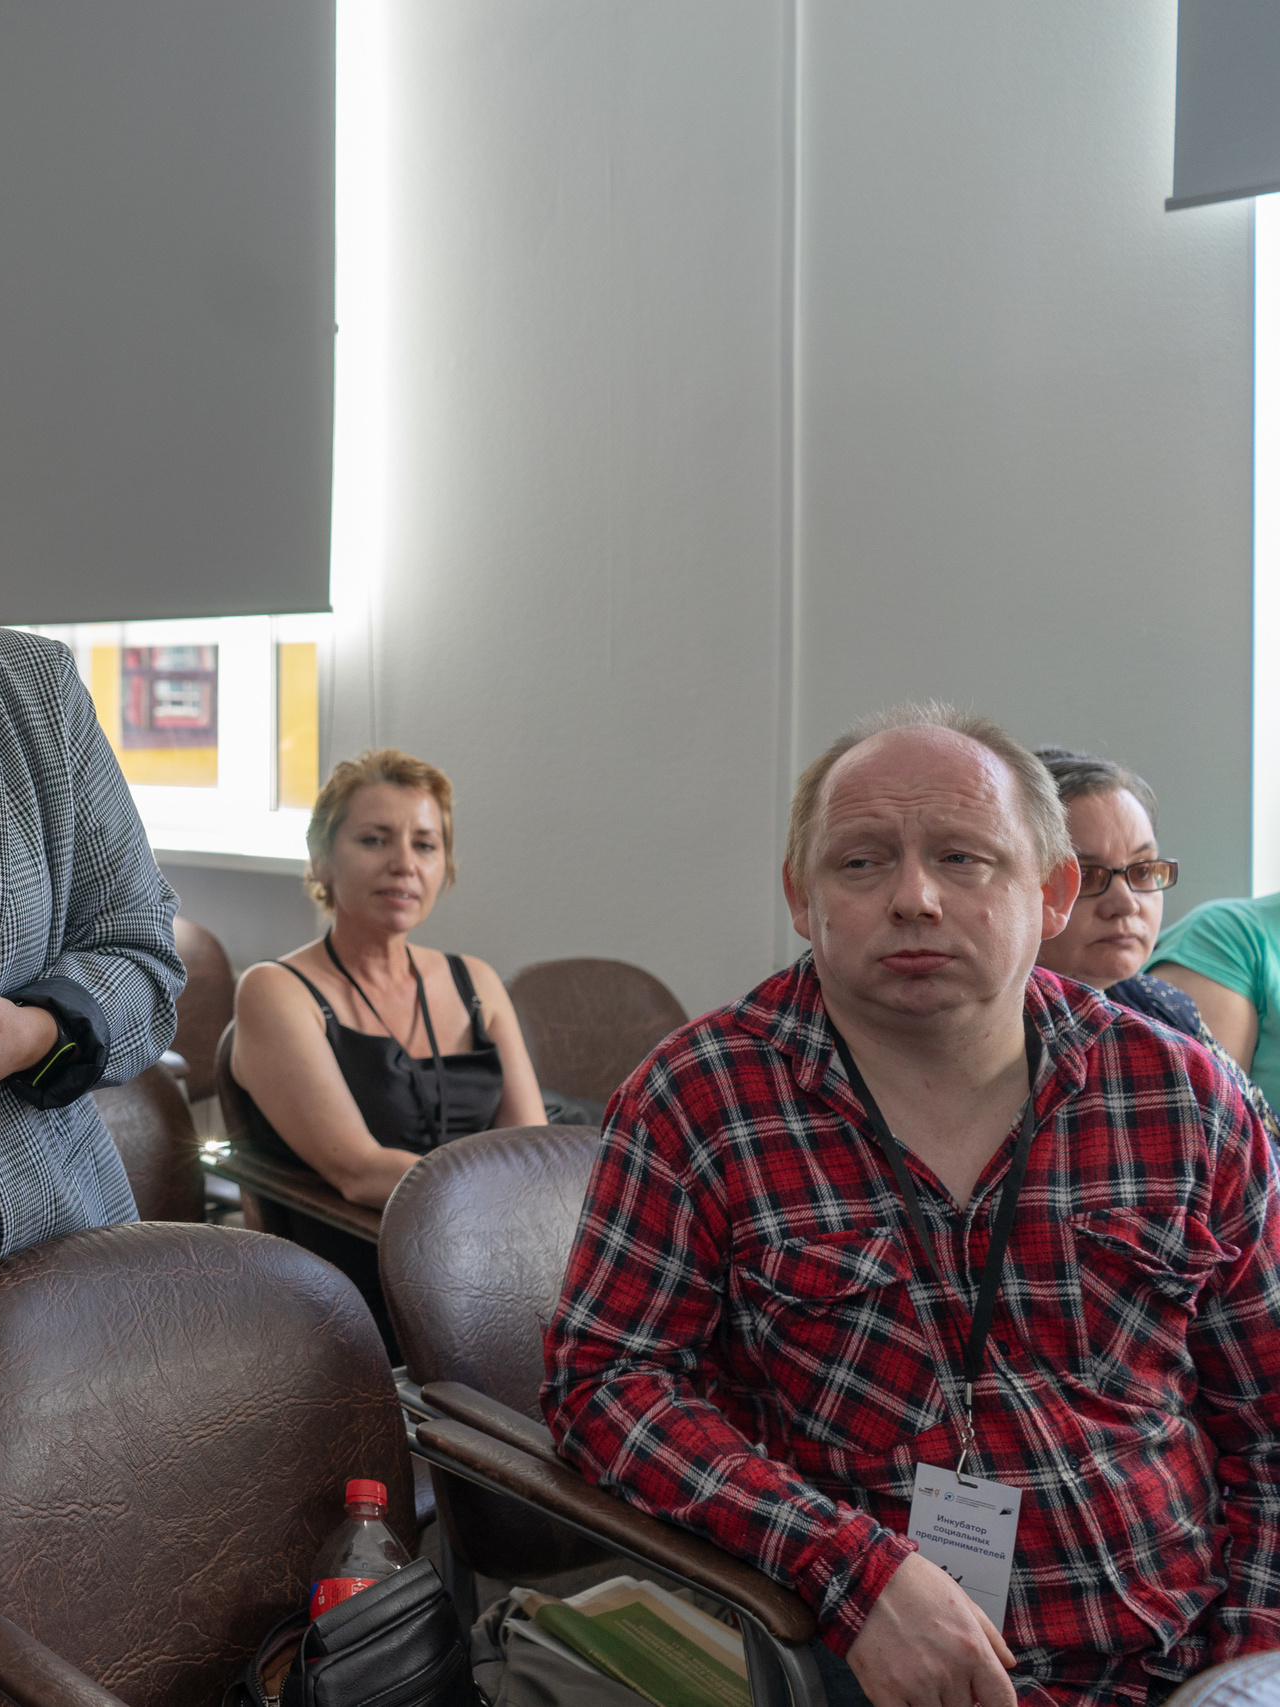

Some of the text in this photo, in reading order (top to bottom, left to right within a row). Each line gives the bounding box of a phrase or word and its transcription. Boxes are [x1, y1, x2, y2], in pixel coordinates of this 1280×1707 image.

[933, 1524, 990, 1546] социальных
[936, 1514, 987, 1536] Инкубатор
[915, 1530, 1006, 1560] предпринимателей
